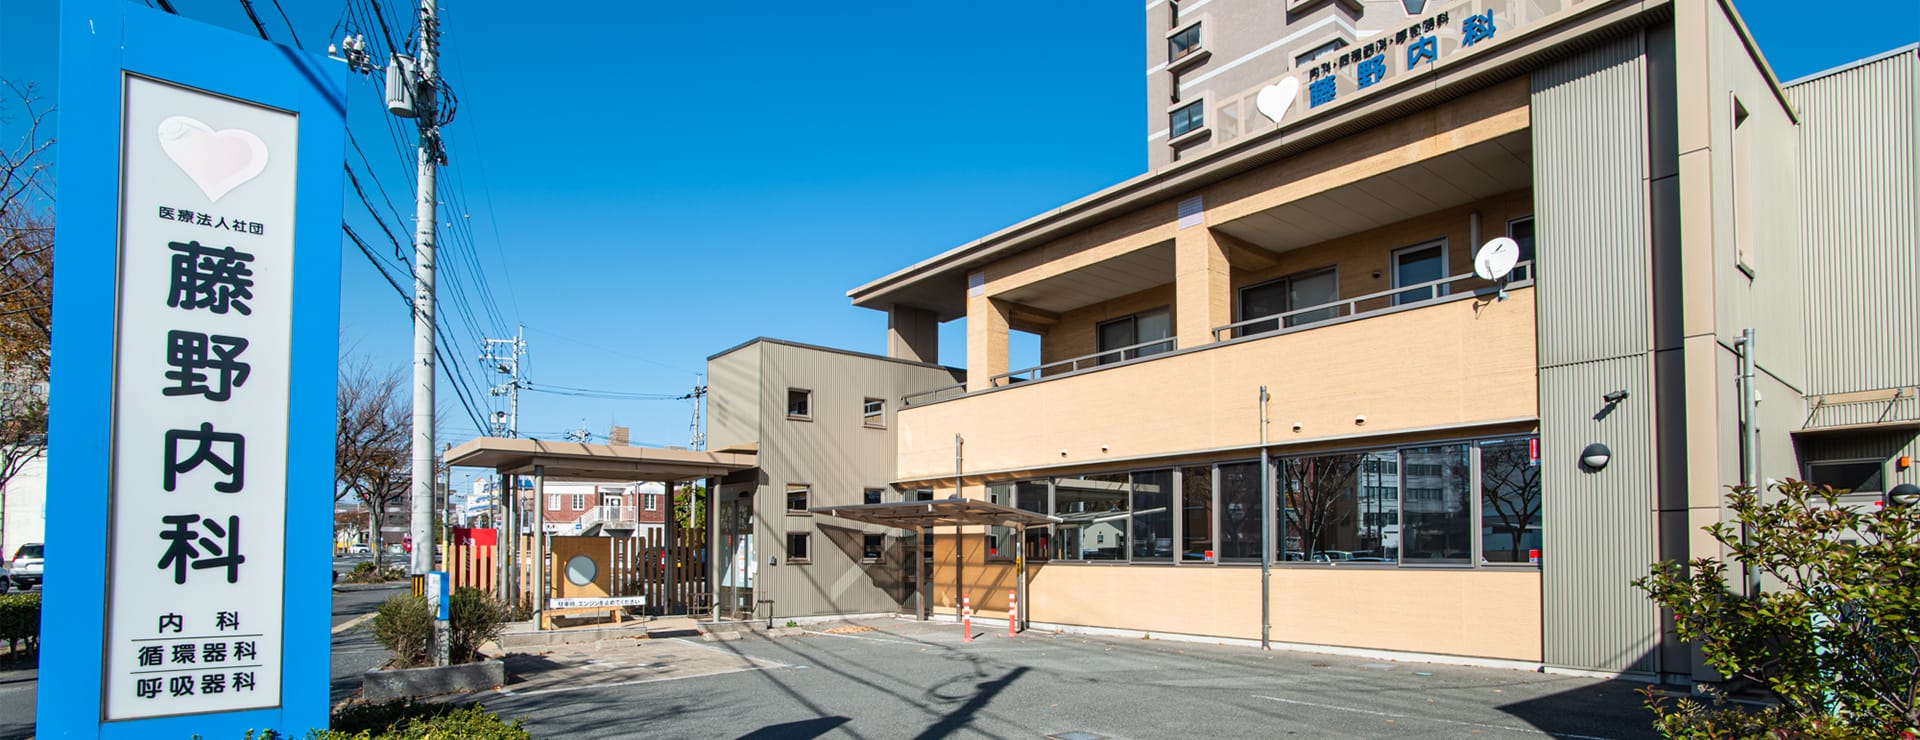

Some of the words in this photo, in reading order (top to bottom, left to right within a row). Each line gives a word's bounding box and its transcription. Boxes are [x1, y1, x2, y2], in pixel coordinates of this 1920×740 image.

[1309, 8, 1496, 109] 藤野内科
[159, 205, 264, 236] 医療法人社団
[157, 240, 255, 586] 藤野内科
[137, 640, 257, 668] 循環器科
[136, 671, 255, 699] 呼吸器科
